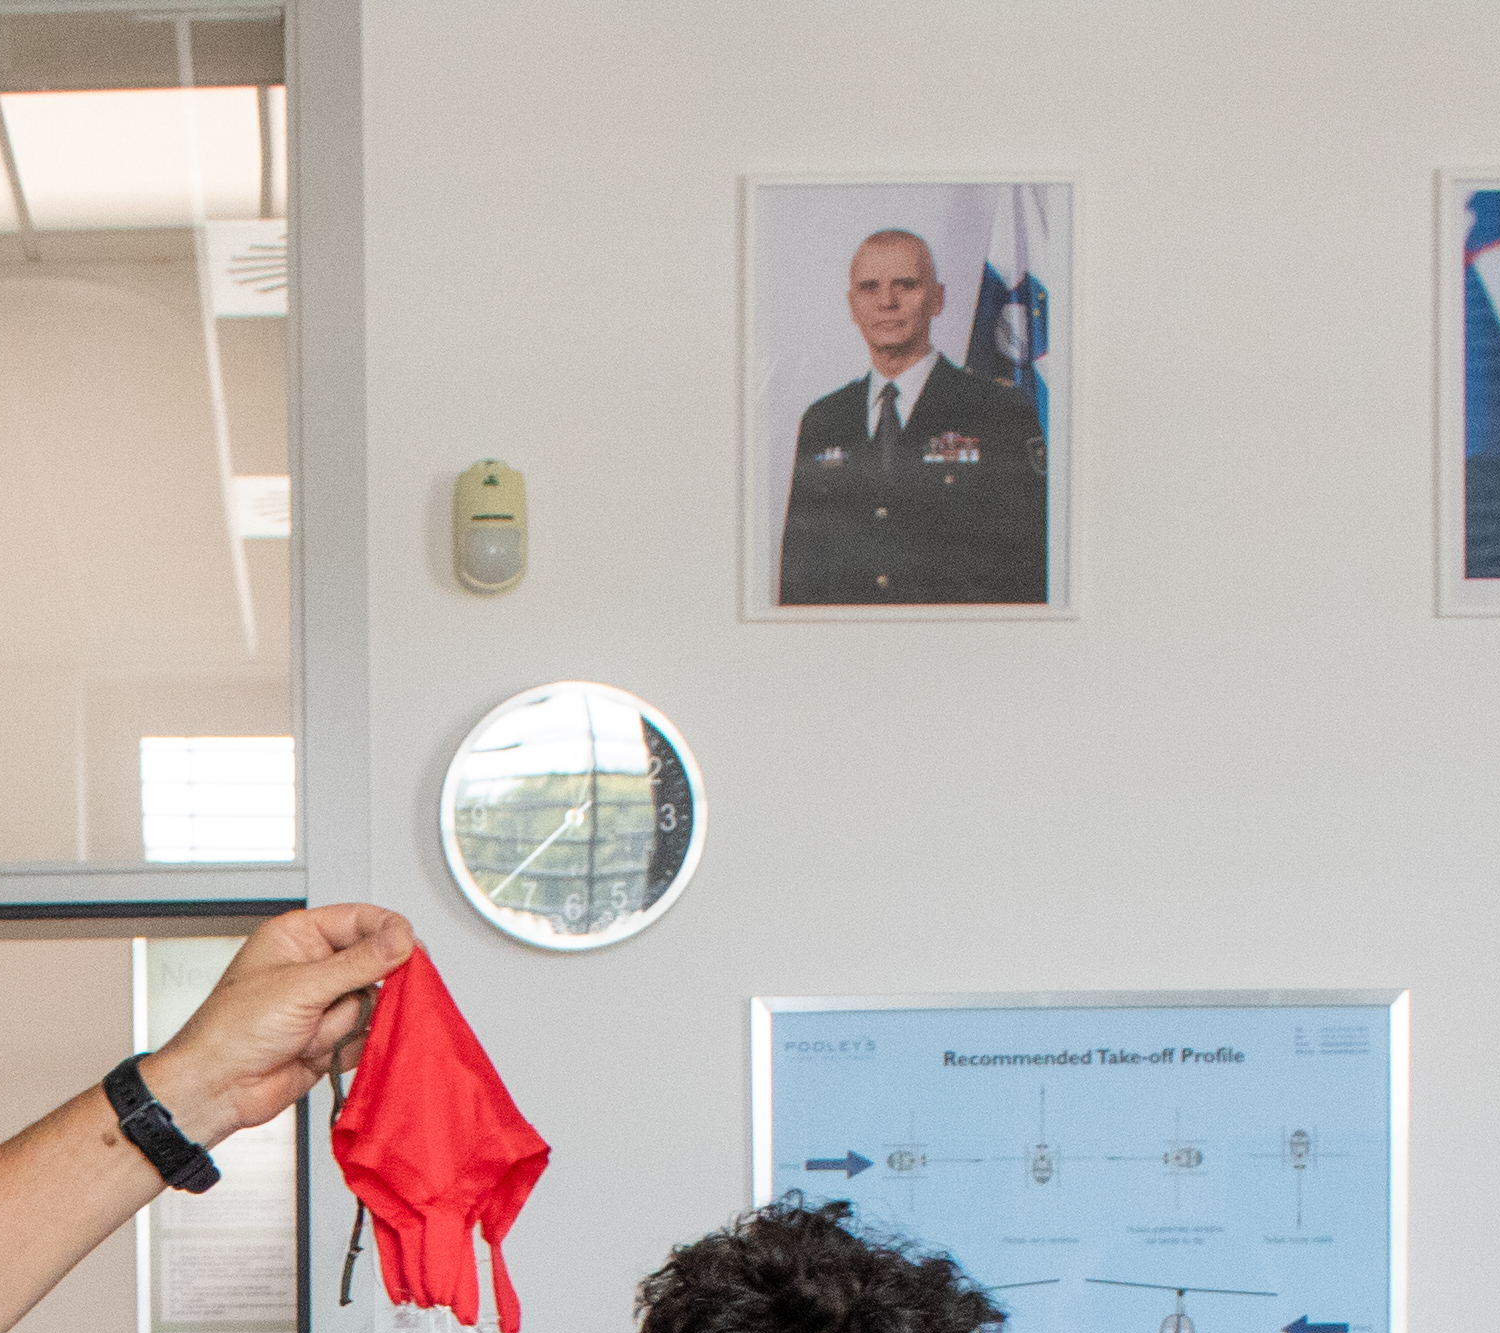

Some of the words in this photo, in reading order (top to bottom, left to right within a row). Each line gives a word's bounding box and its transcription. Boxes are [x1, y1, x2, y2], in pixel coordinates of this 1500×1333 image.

[646, 756, 662, 785] 2
[660, 803, 678, 832] 3
[563, 893, 584, 920] 6
[610, 881, 628, 909] 5
[943, 1048, 1092, 1068] Recommended
[1098, 1047, 1174, 1066] Take-off
[1180, 1046, 1245, 1065] Profile
